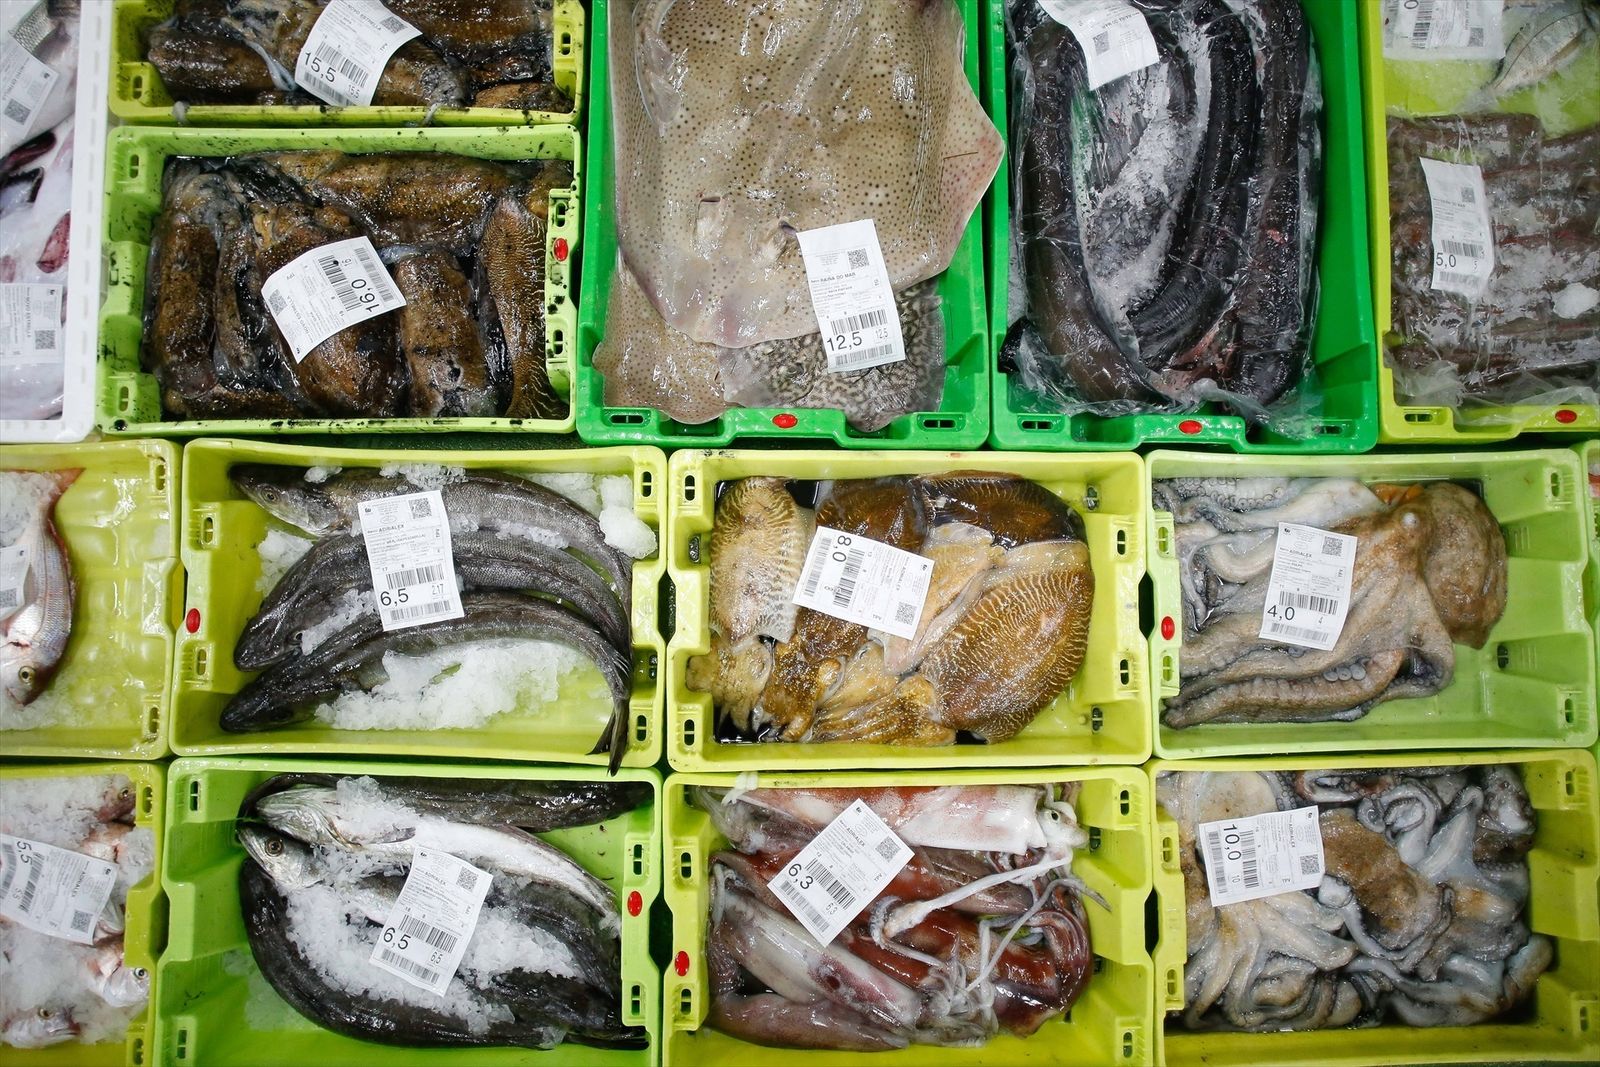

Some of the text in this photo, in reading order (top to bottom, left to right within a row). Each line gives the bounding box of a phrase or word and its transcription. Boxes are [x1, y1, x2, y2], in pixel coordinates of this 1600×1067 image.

[304, 52, 336, 83] 15,5
[1436, 252, 1457, 268] 5,0
[352, 279, 380, 312] 16,0
[827, 331, 863, 351] 12,5
[378, 524, 404, 533] ADRIALEX
[832, 535, 852, 562] 8,0
[1289, 549, 1313, 558] ADRIALEX
[380, 588, 409, 606] 6,5
[1267, 605, 1295, 621] 4,0
[846, 827, 865, 847] ADRIALEX
[1223, 824, 1242, 860] 10,0
[16, 840, 33, 865] 5,5
[72, 871, 86, 897] ADRIALEX
[425, 872, 446, 886] ADRIALEX
[788, 863, 814, 890] 6,3
[383, 927, 411, 950] 6,5
